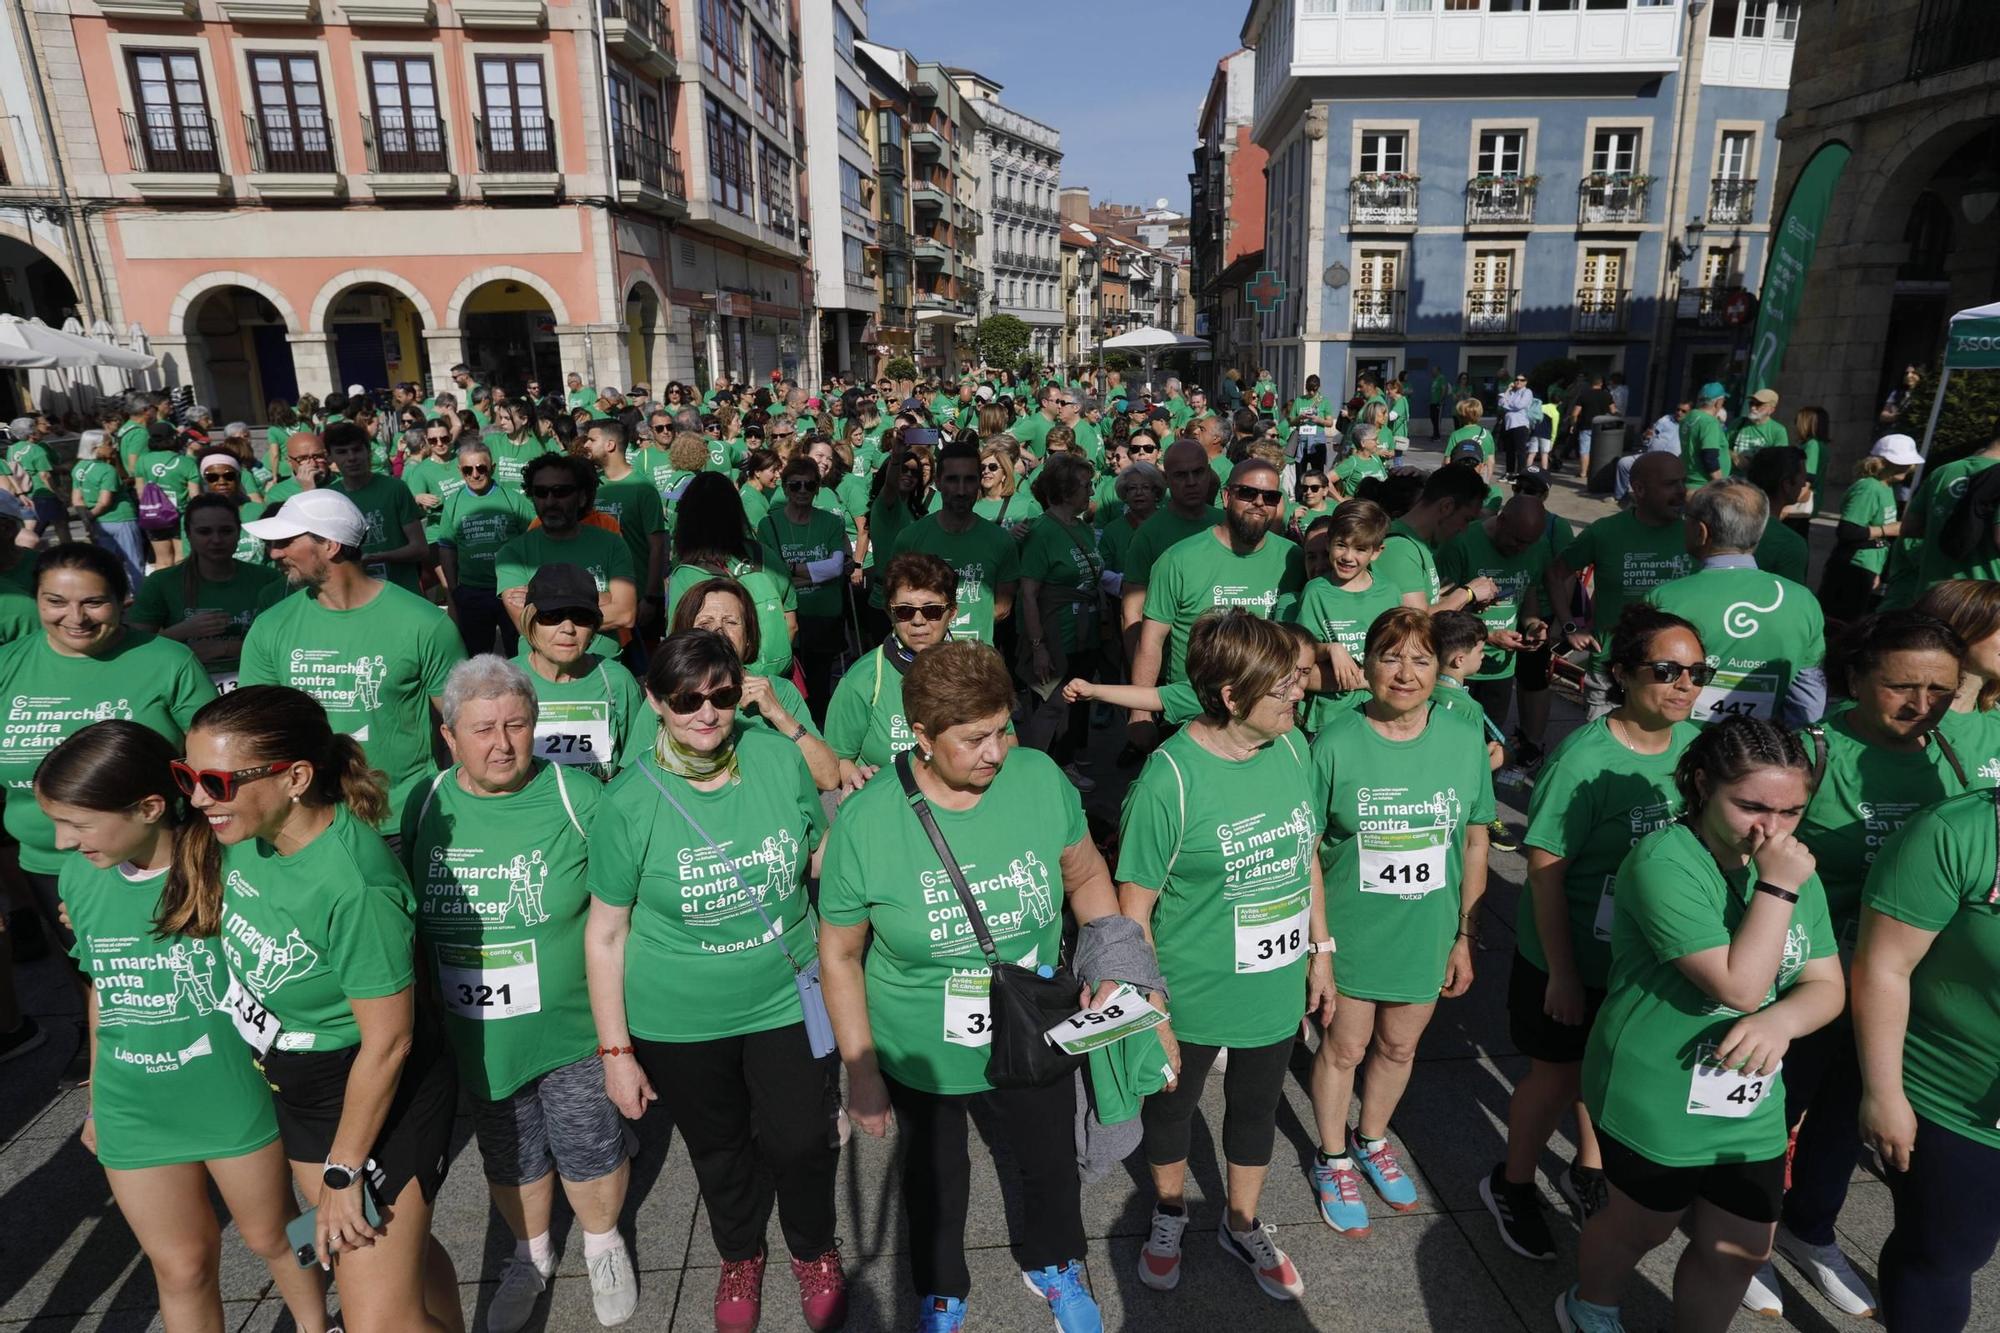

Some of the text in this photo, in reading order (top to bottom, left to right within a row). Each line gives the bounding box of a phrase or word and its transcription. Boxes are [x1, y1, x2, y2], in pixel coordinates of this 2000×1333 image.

[1474, 262, 1486, 283] ORO
[1495, 262, 1507, 283] ORO
[1584, 261, 1596, 282] ORO
[1604, 261, 1617, 282] ORO
[1624, 561, 1637, 569] En
[1623, 577, 1670, 586] el cánce
[1624, 570, 1656, 578] contra
[1214, 596, 1228, 606] En
[1337, 631, 1367, 642] marc
[290, 661, 364, 674] En marcha
[290, 675, 336, 686] contra
[8, 708, 105, 721] En marcha
[1710, 699, 1757, 716] 447
[5, 722, 61, 734] contra
[890, 726, 909, 739] En
[2, 734, 67, 748] el cánc
[545, 734, 593, 754] 275
[1358, 800, 1443, 817] En marcha
[1359, 818, 1410, 831] contra
[1632, 820, 1651, 833] En
[1865, 818, 1889, 831] En
[1221, 840, 1245, 857] En
[1248, 821, 1304, 848] marcha
[1225, 847, 1275, 872] contra
[428, 863, 521, 879] En marcha
[679, 865, 704, 880] En
[1225, 856, 1296, 883] el cáncer
[1379, 862, 1431, 884] 418
[425, 882, 479, 896] contra
[680, 876, 738, 898] contra
[923, 874, 1024, 905] En archa
[422, 898, 507, 914] el cáncer
[681, 900, 698, 913] el
[705, 884, 765, 911] cáncer
[928, 900, 987, 922] cona
[930, 924, 948, 941] el
[701, 937, 761, 953] LABORAL
[1257, 928, 1301, 960] 318
[110, 953, 181, 971] marcha
[952, 967, 992, 977] LABO
[94, 973, 144, 989] ontra
[957, 983, 982, 991] cáncer
[110, 989, 175, 1008] cáncer
[457, 984, 511, 1006] 321
[1067, 1005, 1125, 1029] 851
[115, 1047, 177, 1064] LABORAL
[146, 1063, 179, 1073] kutxa
[1727, 1081, 1763, 1104] 43
